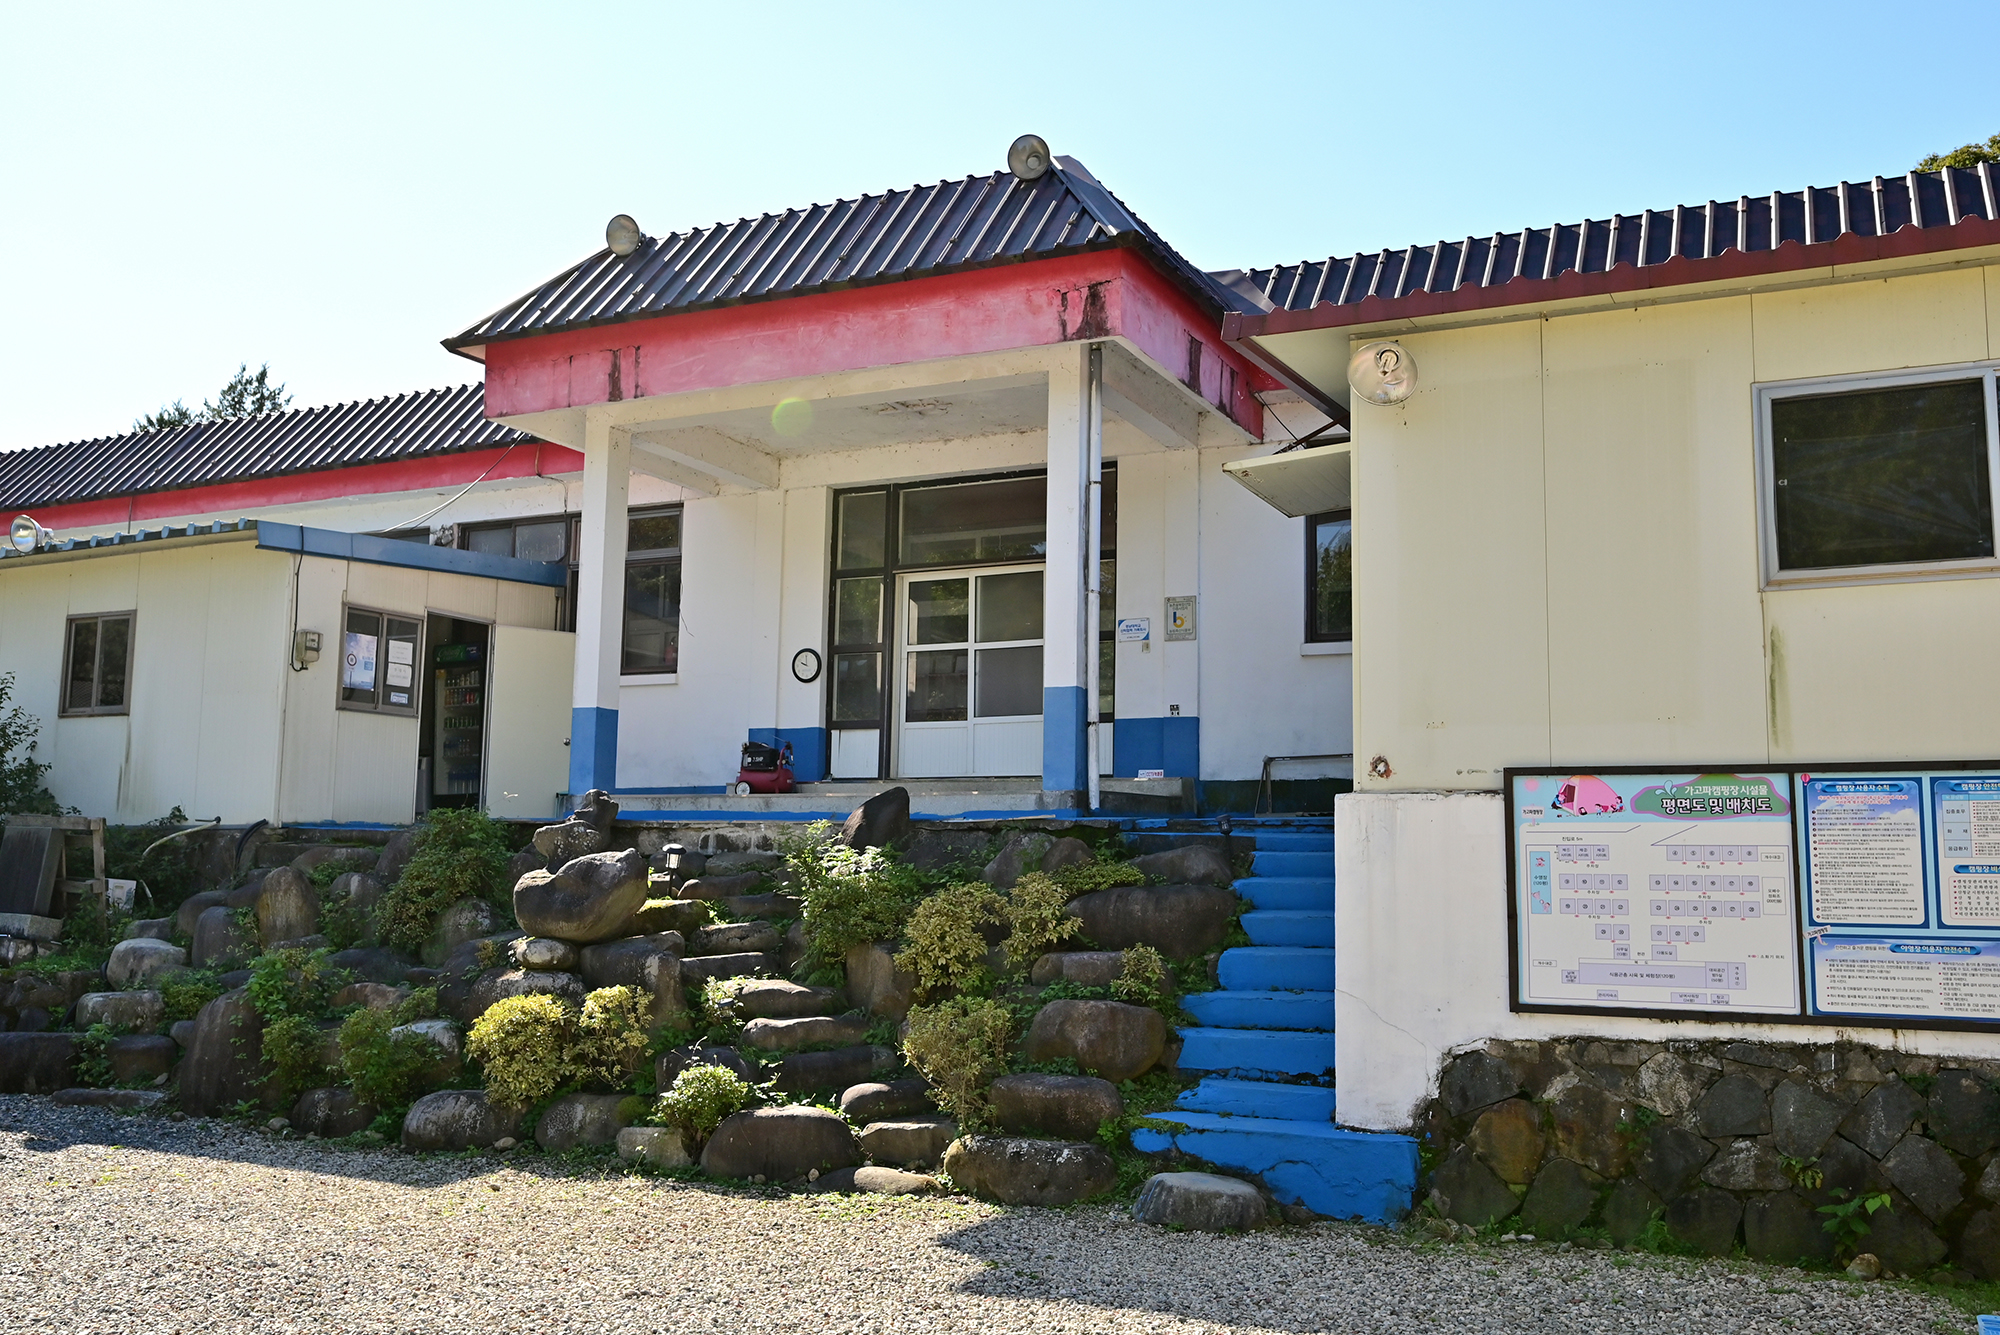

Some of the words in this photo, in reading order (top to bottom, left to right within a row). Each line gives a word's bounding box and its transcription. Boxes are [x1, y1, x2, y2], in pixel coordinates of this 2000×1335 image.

[1684, 785, 1740, 796] 가고파캠핑장
[1740, 785, 1768, 796] 시설물
[1836, 784, 1855, 792] 캠핑장
[1856, 784, 1876, 792] 사용자
[1876, 784, 1890, 792] 수칙
[1661, 797, 1707, 814] 평면도
[1708, 797, 1724, 814] 및
[1726, 797, 1772, 814] 배치도
[1922, 945, 1942, 953] 이용자
[1943, 946, 1971, 954] 안전수칙
